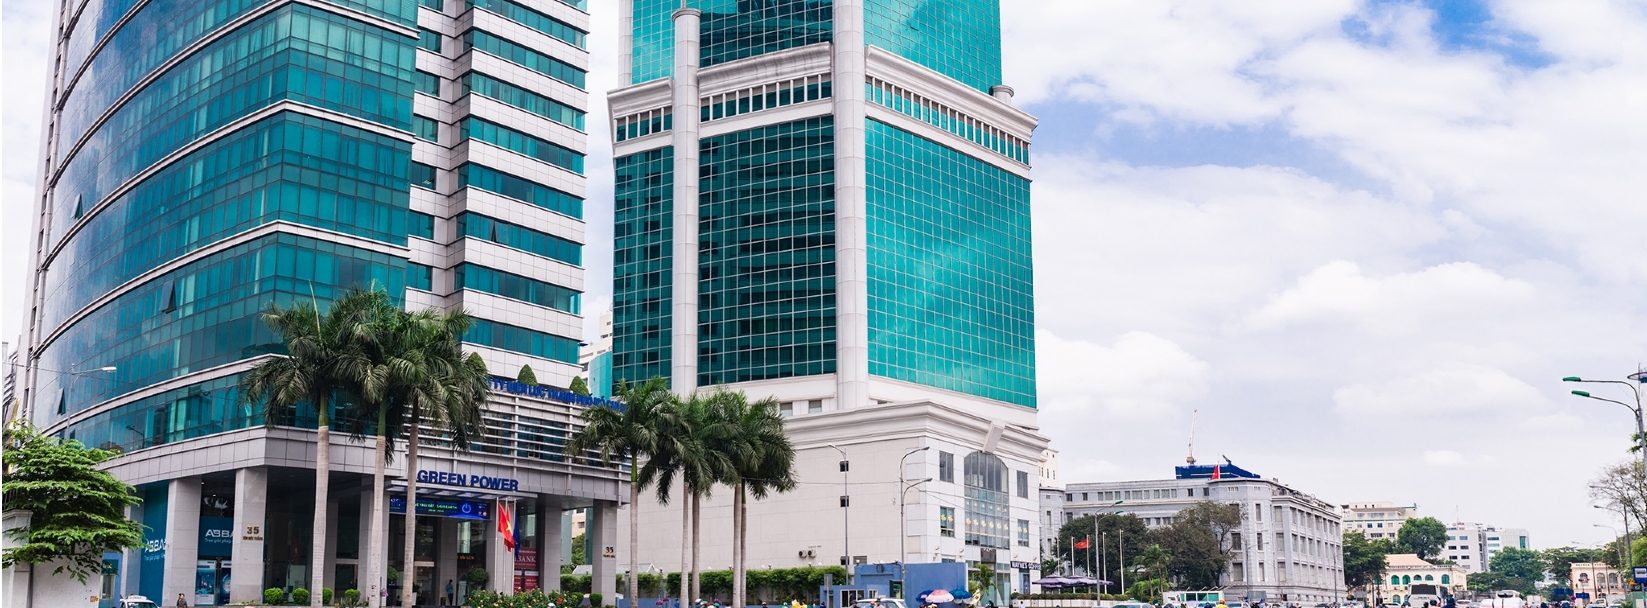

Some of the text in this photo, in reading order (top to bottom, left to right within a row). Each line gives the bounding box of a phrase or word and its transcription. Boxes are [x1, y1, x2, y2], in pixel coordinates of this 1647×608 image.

[417, 470, 518, 491] GREEN POWER
[247, 525, 259, 535] 35
[606, 546, 614, 554] 35
